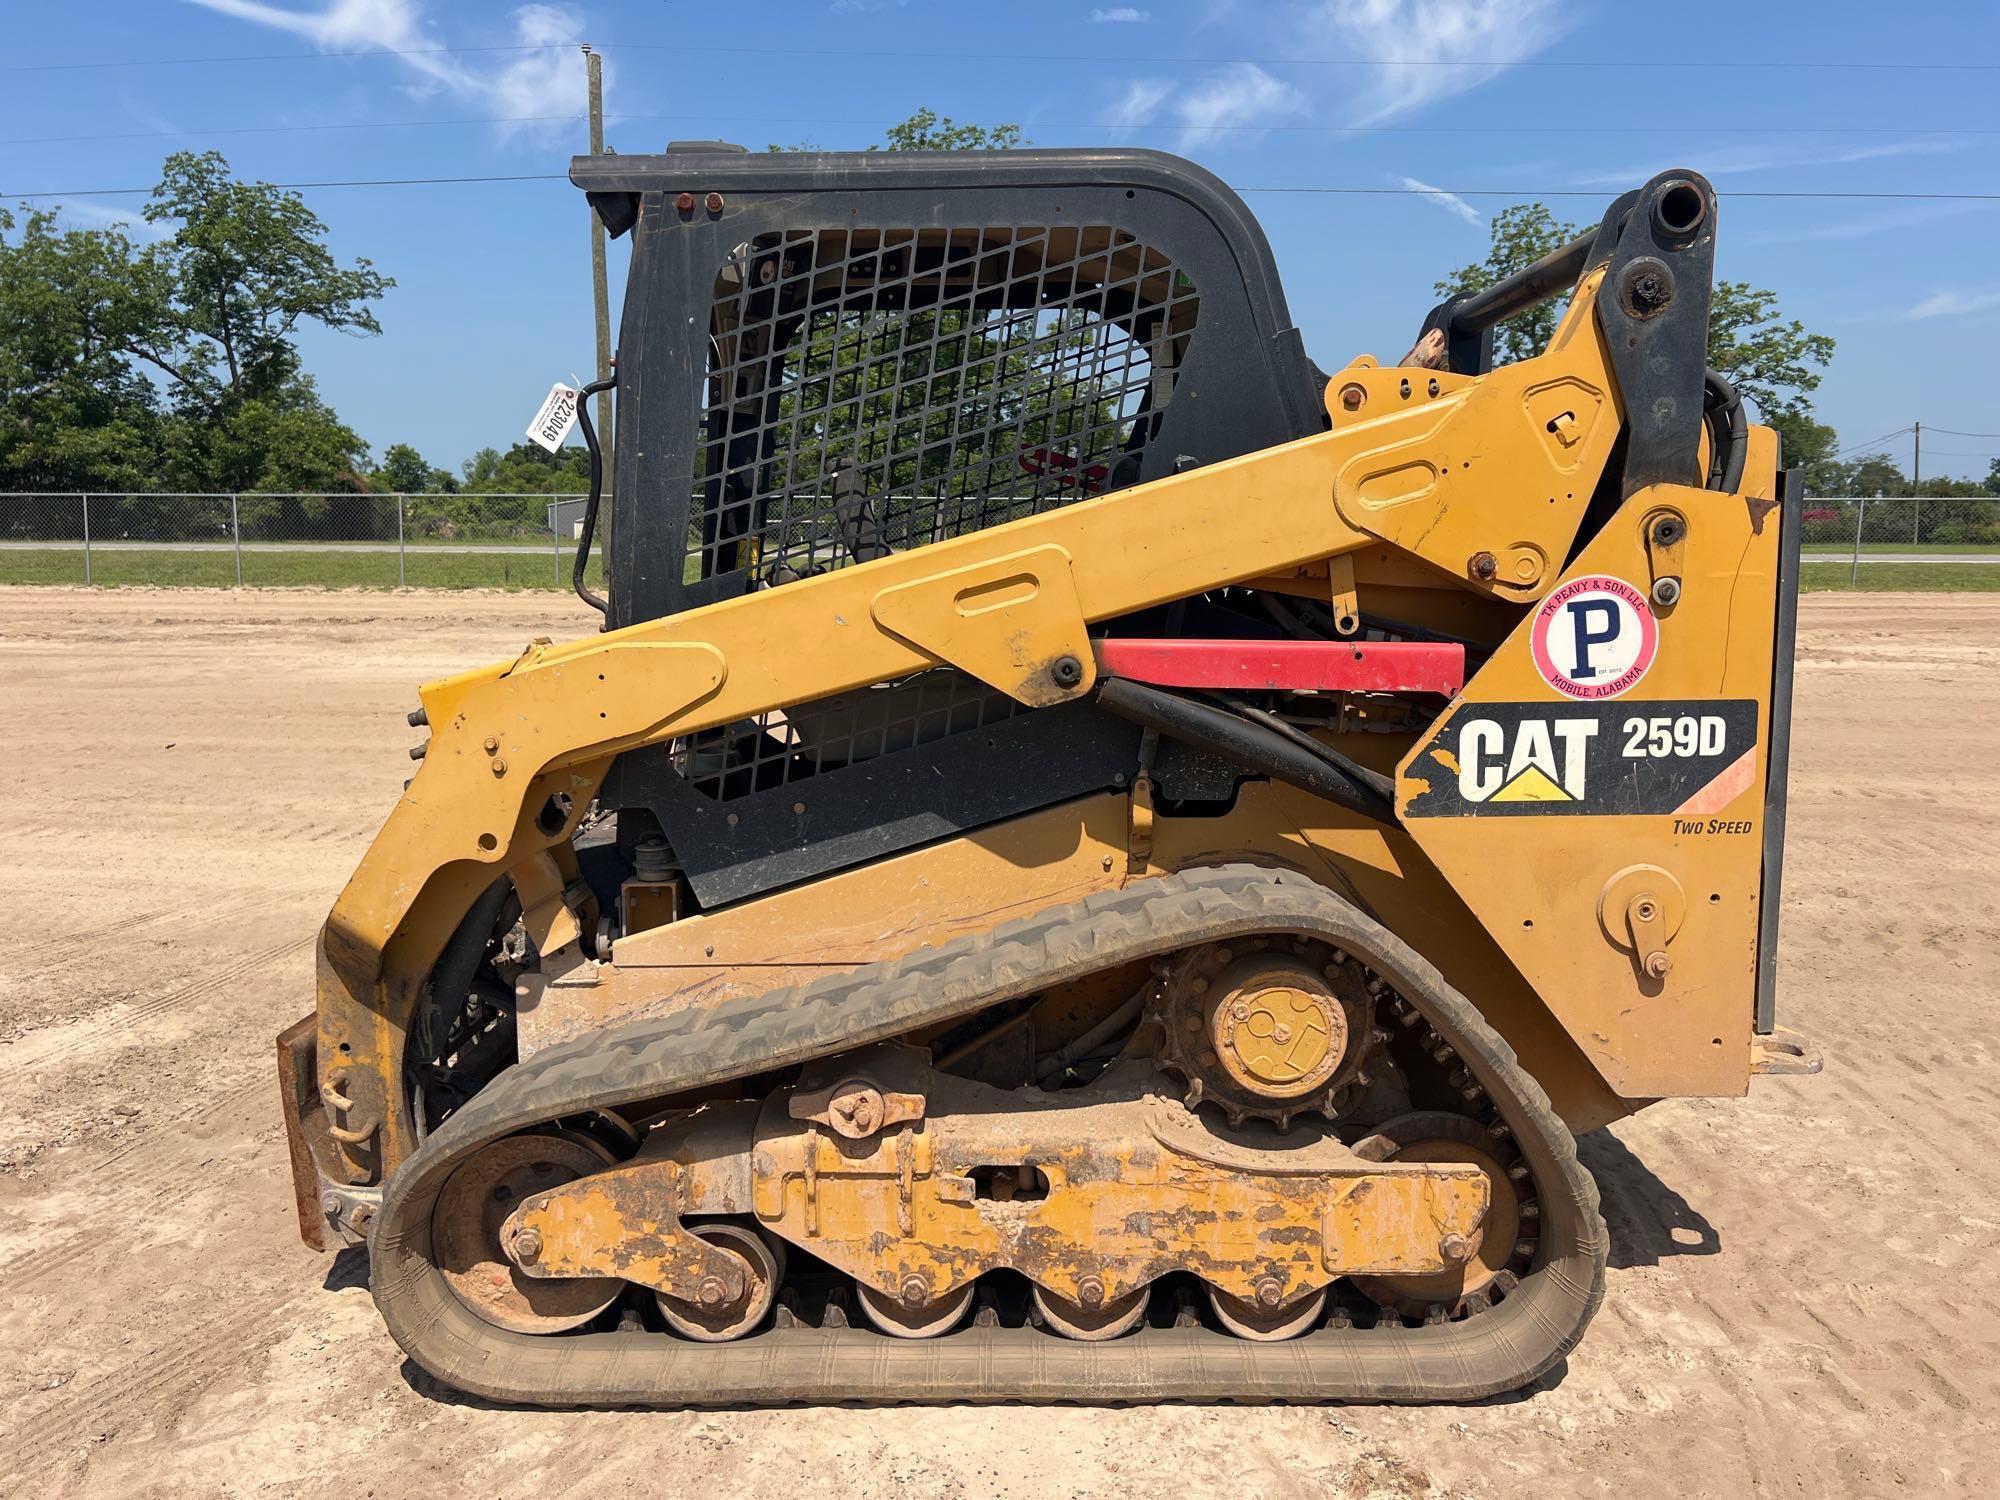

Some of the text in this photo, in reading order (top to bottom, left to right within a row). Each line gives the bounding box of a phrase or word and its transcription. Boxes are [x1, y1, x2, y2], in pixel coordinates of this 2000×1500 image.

[542, 399, 575, 441] 223049
[1542, 580, 1645, 617] TK PEAVY & SON LLC
[1567, 598, 1621, 679] P
[1596, 666, 1643, 697] ALABAMA
[1622, 716, 1726, 758] 259D
[1459, 718, 1599, 802] CAT
